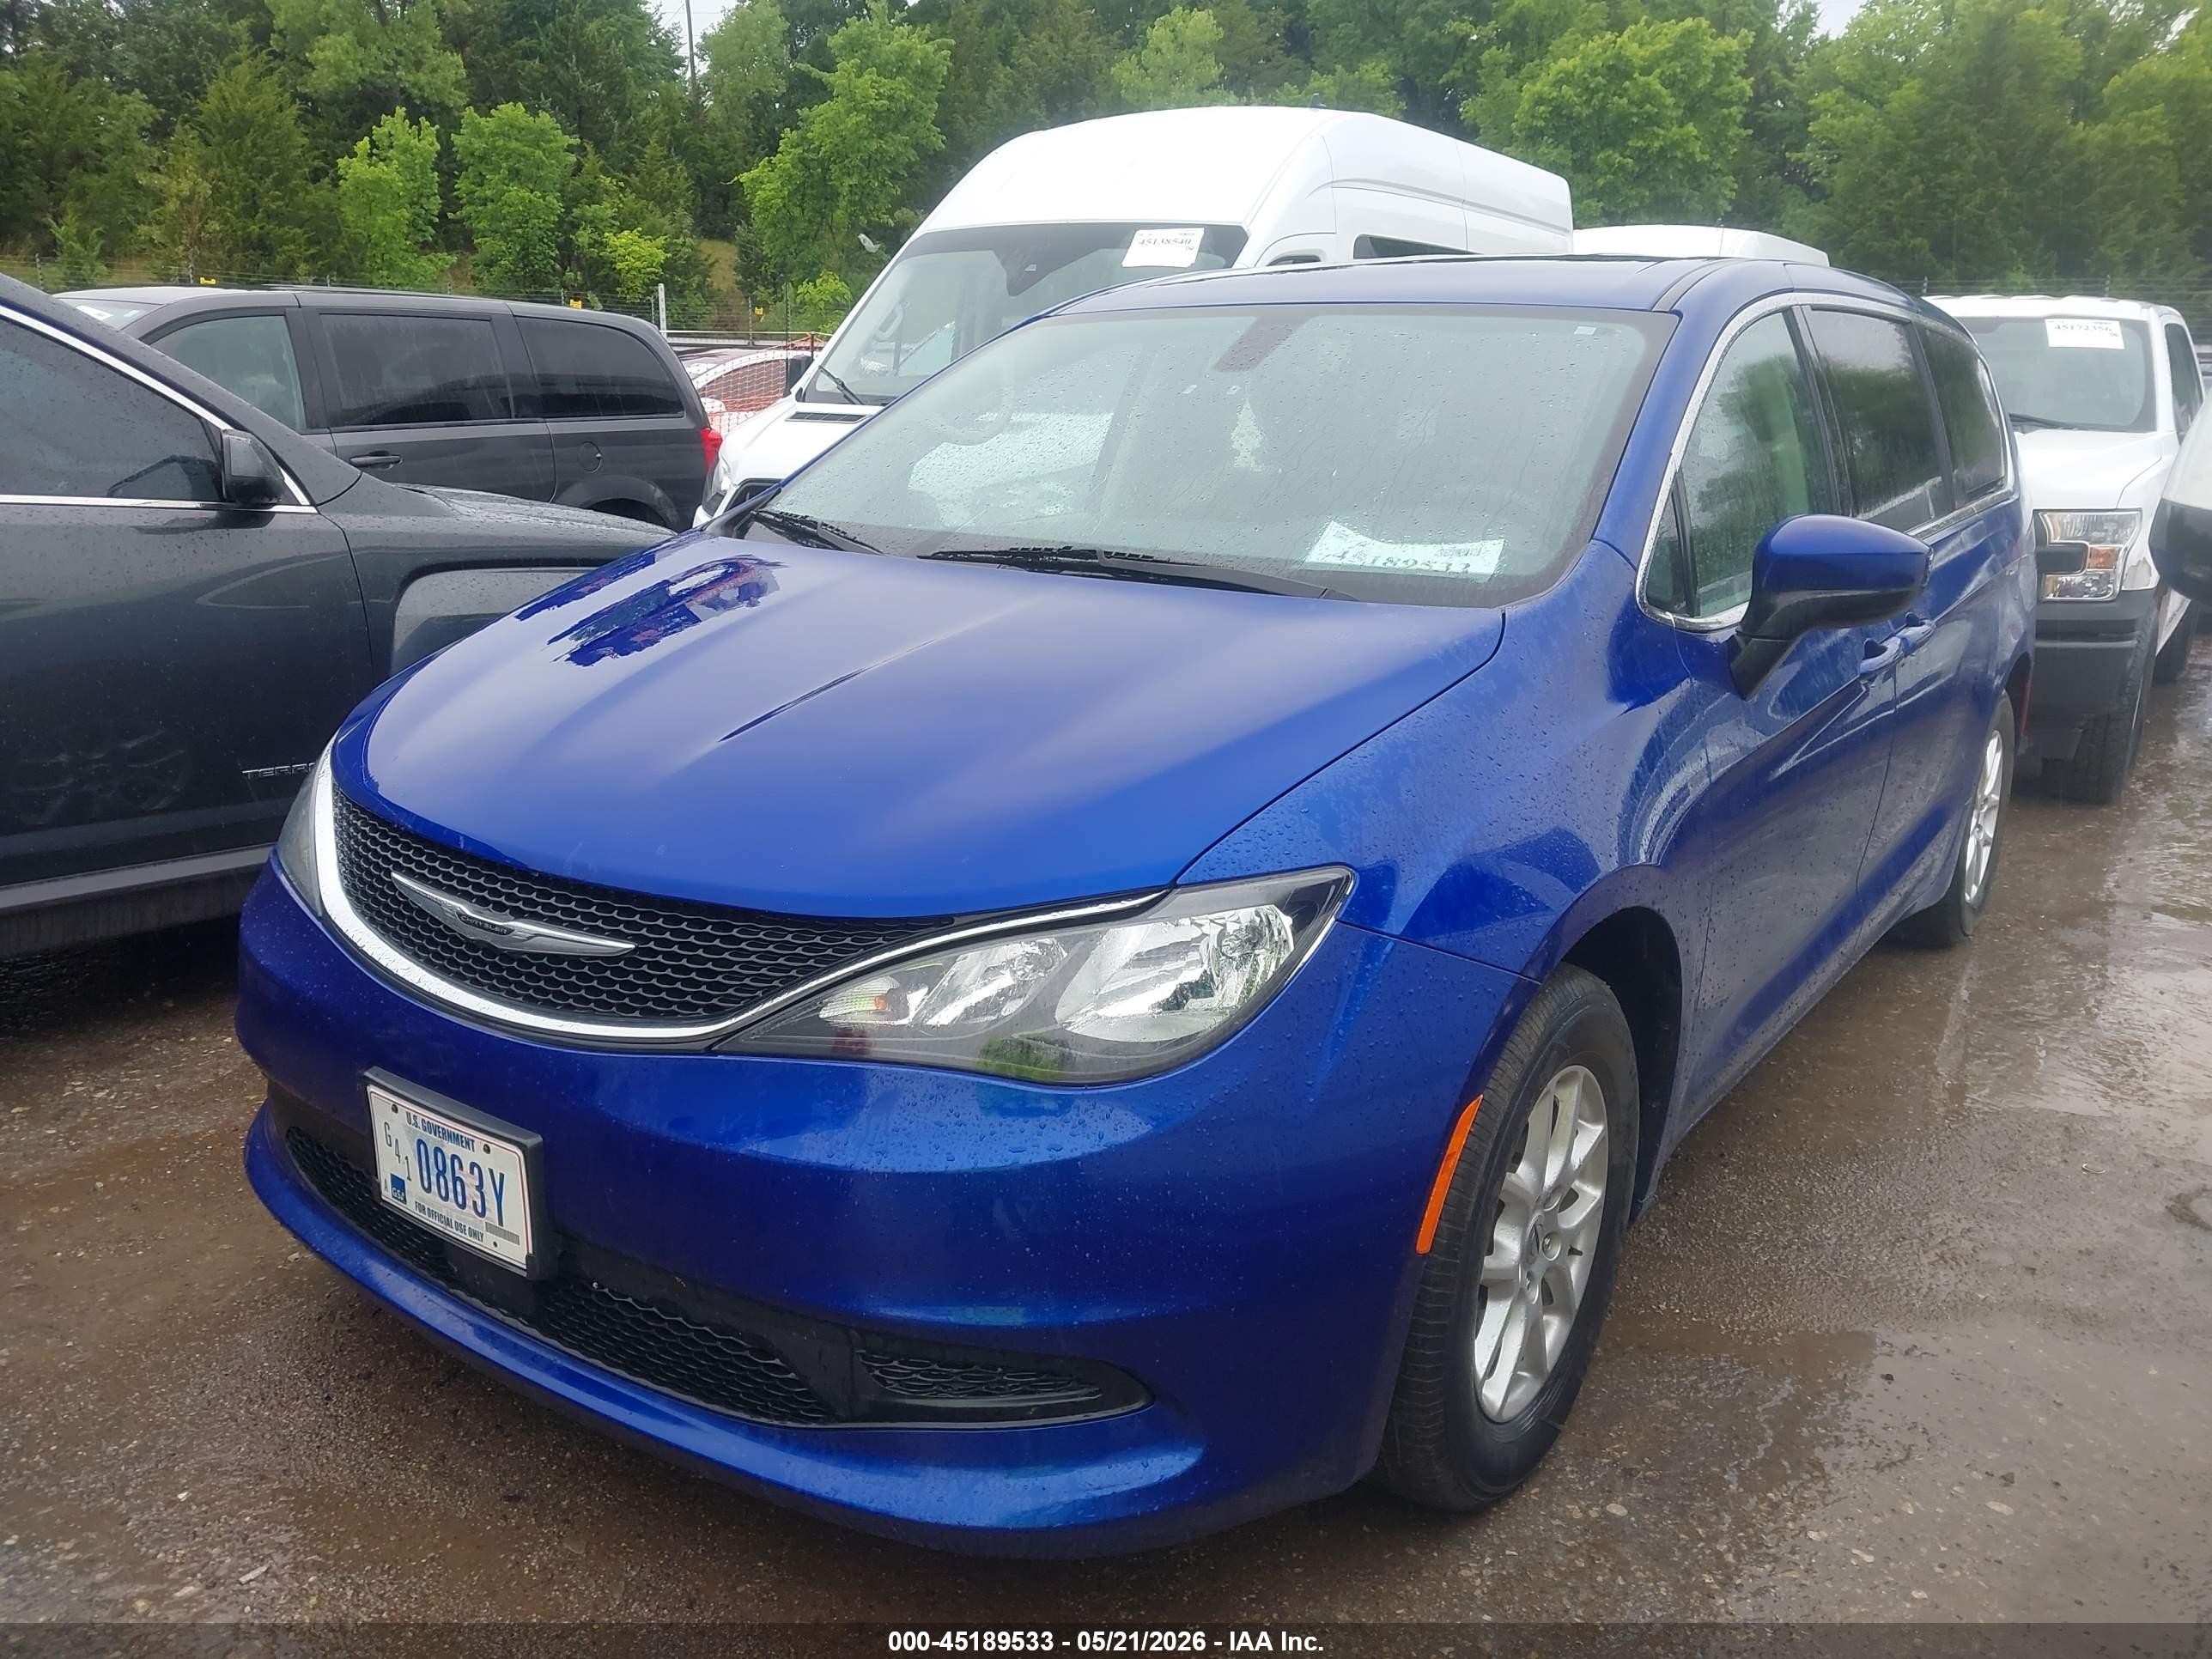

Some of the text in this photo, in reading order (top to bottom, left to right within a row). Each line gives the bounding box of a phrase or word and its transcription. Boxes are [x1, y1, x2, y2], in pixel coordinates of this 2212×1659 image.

[460, 915, 507, 934] CHRYSLER
[406, 1111, 476, 1152] U.S. GOVERNMENT
[416, 1138, 505, 1227] 0863Y
[415, 1201, 484, 1243] FOR OFFICIAL USE ONLY
